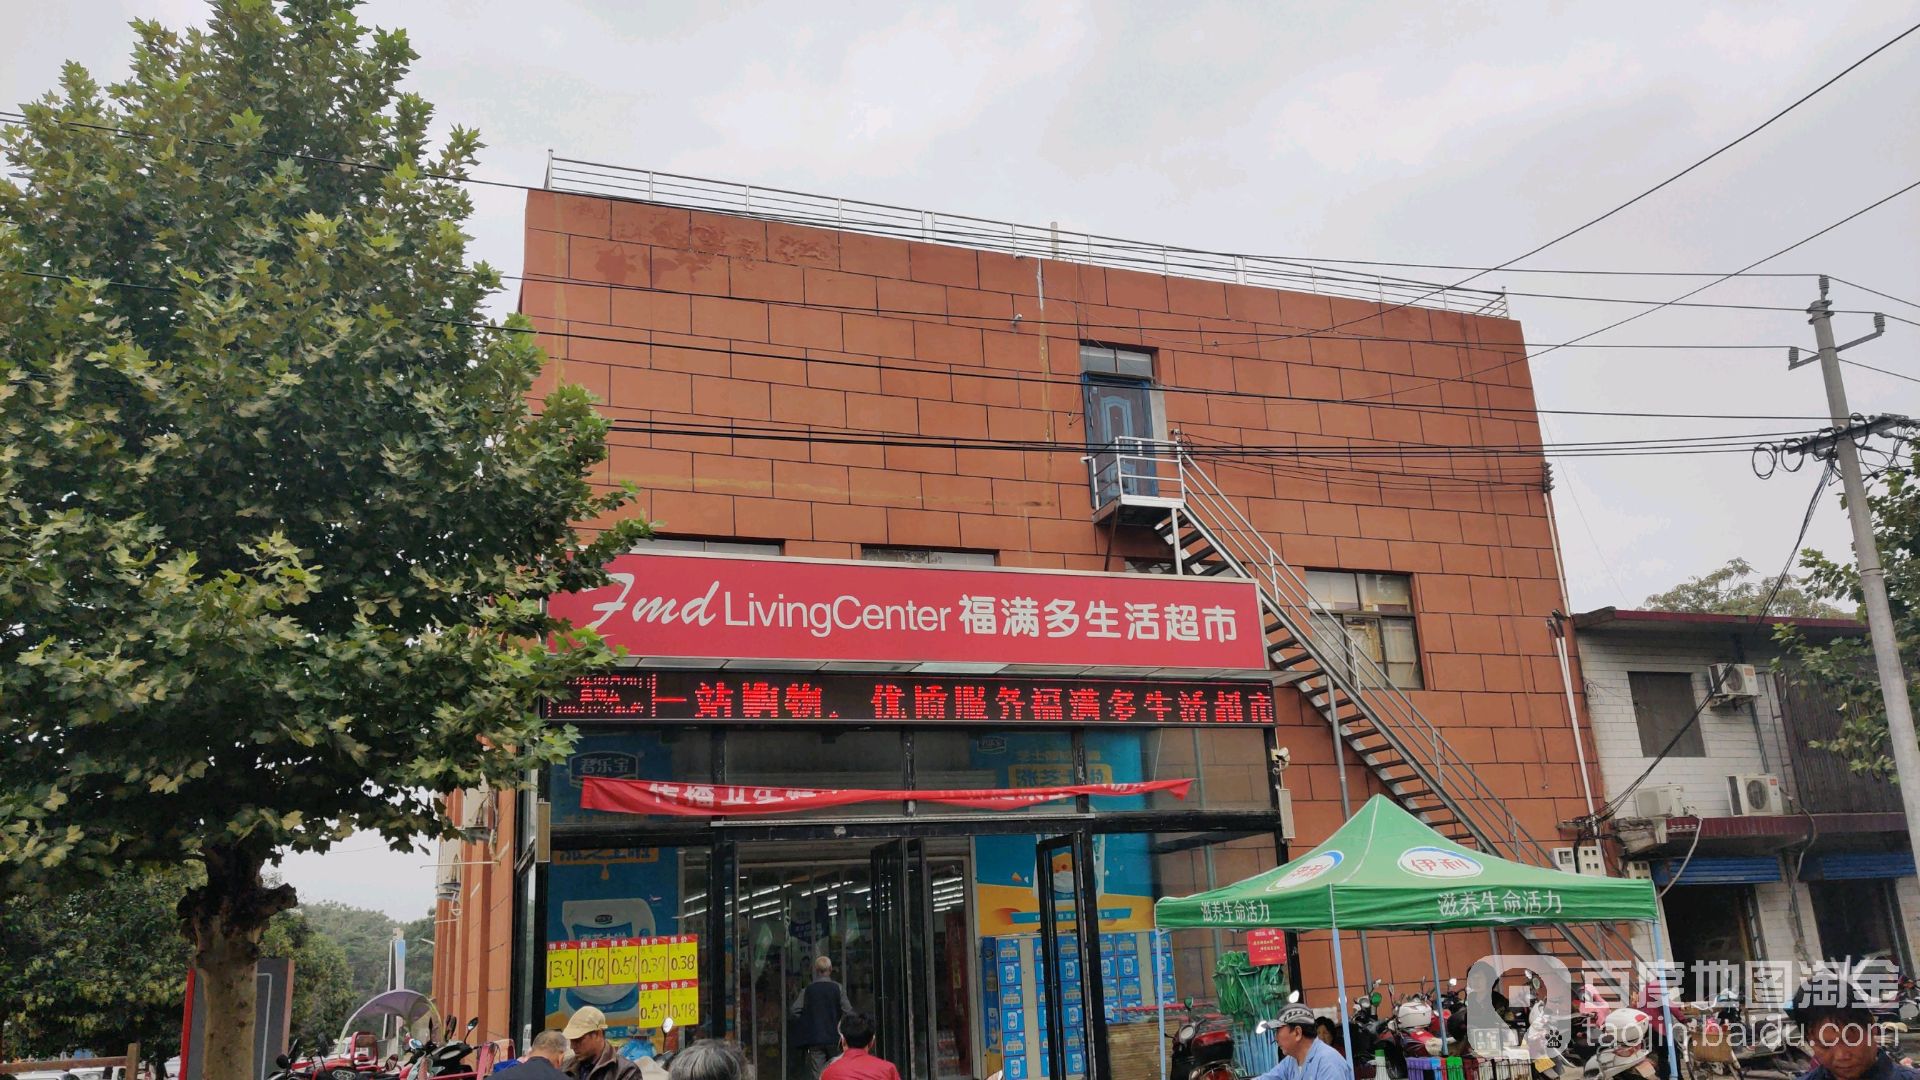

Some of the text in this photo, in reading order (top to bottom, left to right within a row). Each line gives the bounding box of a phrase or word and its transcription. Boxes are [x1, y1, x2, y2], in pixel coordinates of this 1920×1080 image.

[724, 591, 952, 638] LivingCenter
[958, 593, 1238, 643] 福满多生活超市
[580, 757, 630, 774] 君乐宝
[1410, 858, 1470, 872] 伊利
[1200, 899, 1270, 922] 滋养生命活力
[1437, 889, 1562, 917] 滋养生命活力
[670, 954, 696, 971] 0.38
